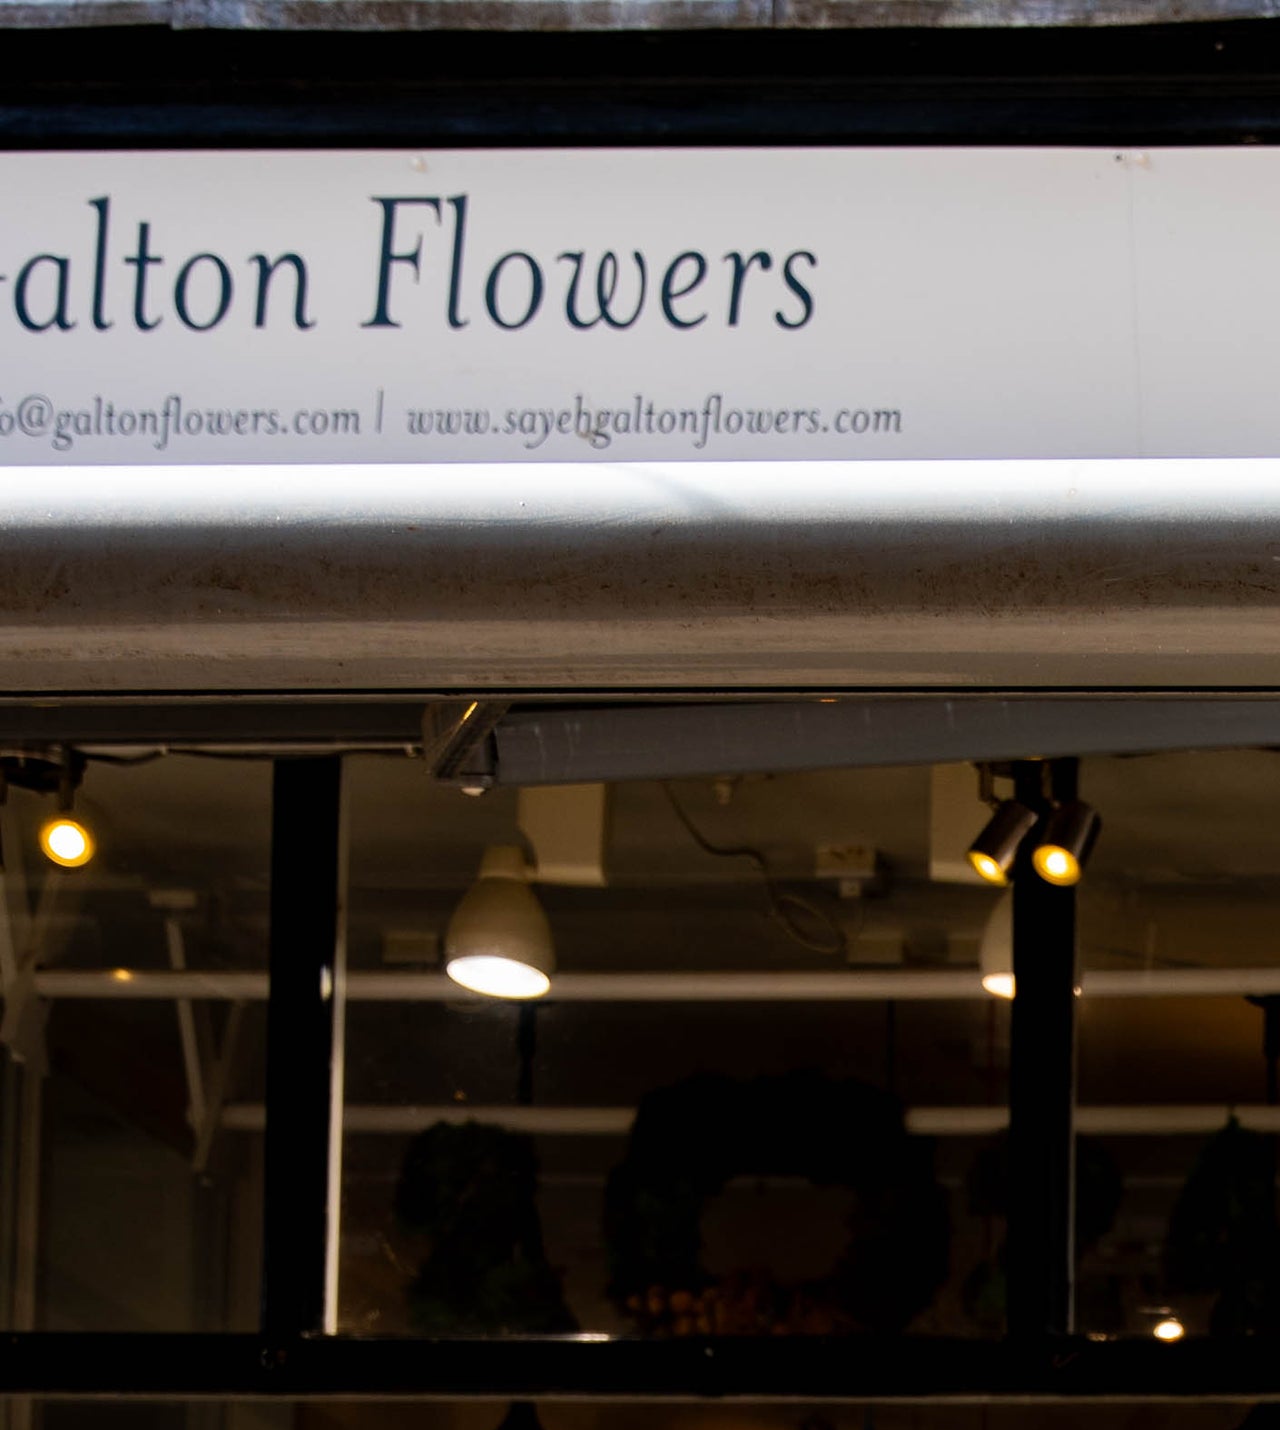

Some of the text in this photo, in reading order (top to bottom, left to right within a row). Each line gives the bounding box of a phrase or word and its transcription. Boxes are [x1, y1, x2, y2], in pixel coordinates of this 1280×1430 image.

[0, 194, 818, 332] alton Flowers
[407, 393, 903, 451] www.sayehgaltonflowers.com
